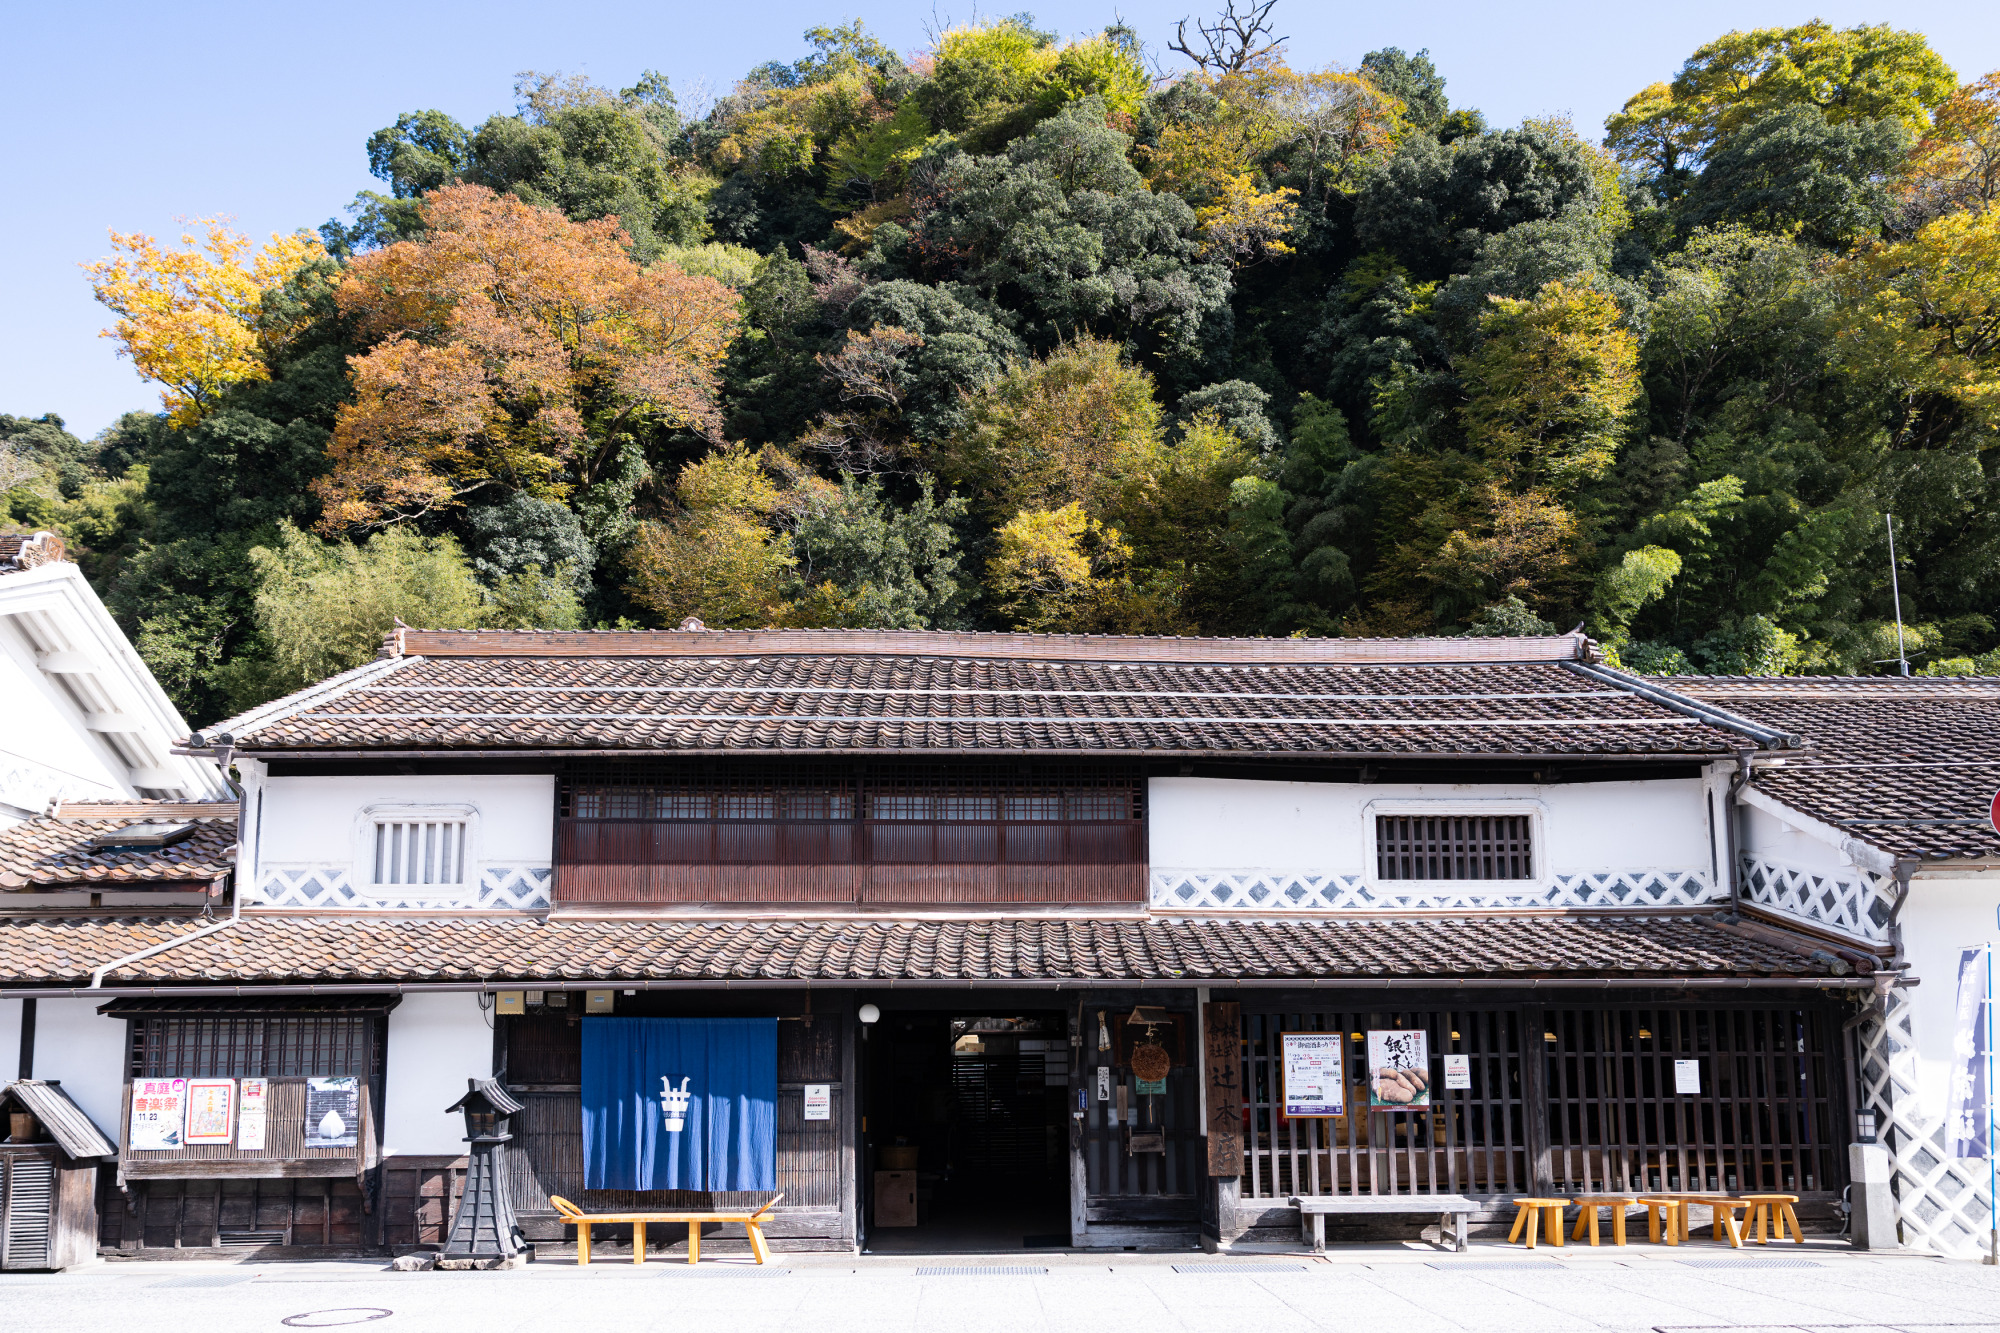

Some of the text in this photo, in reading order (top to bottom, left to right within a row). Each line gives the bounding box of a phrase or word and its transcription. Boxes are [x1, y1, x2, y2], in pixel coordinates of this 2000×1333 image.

[1402, 1033, 1414, 1069] やまのいも
[143, 1082, 170, 1095] 真庭
[134, 1097, 178, 1111] 音楽祭
[1213, 1064, 1240, 1175] 辻本店
